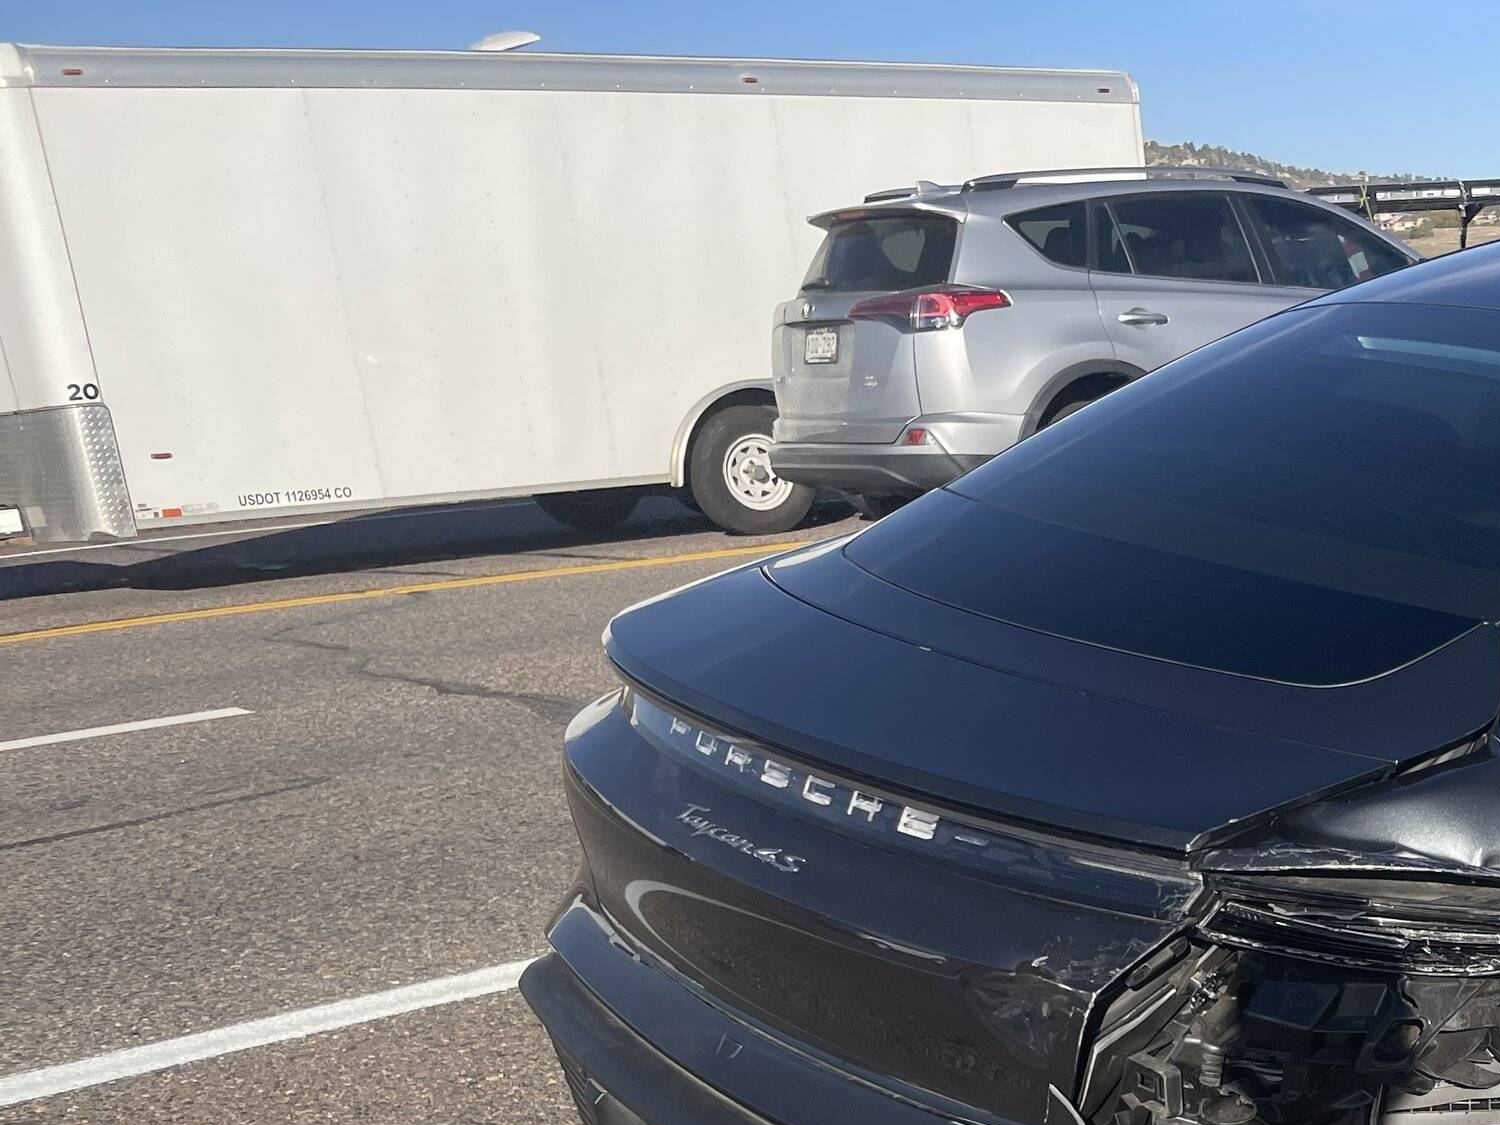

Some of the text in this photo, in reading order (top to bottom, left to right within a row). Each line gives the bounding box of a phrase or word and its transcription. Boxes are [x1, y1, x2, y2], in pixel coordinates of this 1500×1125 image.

[66, 382, 99, 401] 20
[238, 486, 352, 506] USDOT 1126954 CO
[669, 716, 941, 841] PORSCHE
[675, 803, 754, 855] Taycan
